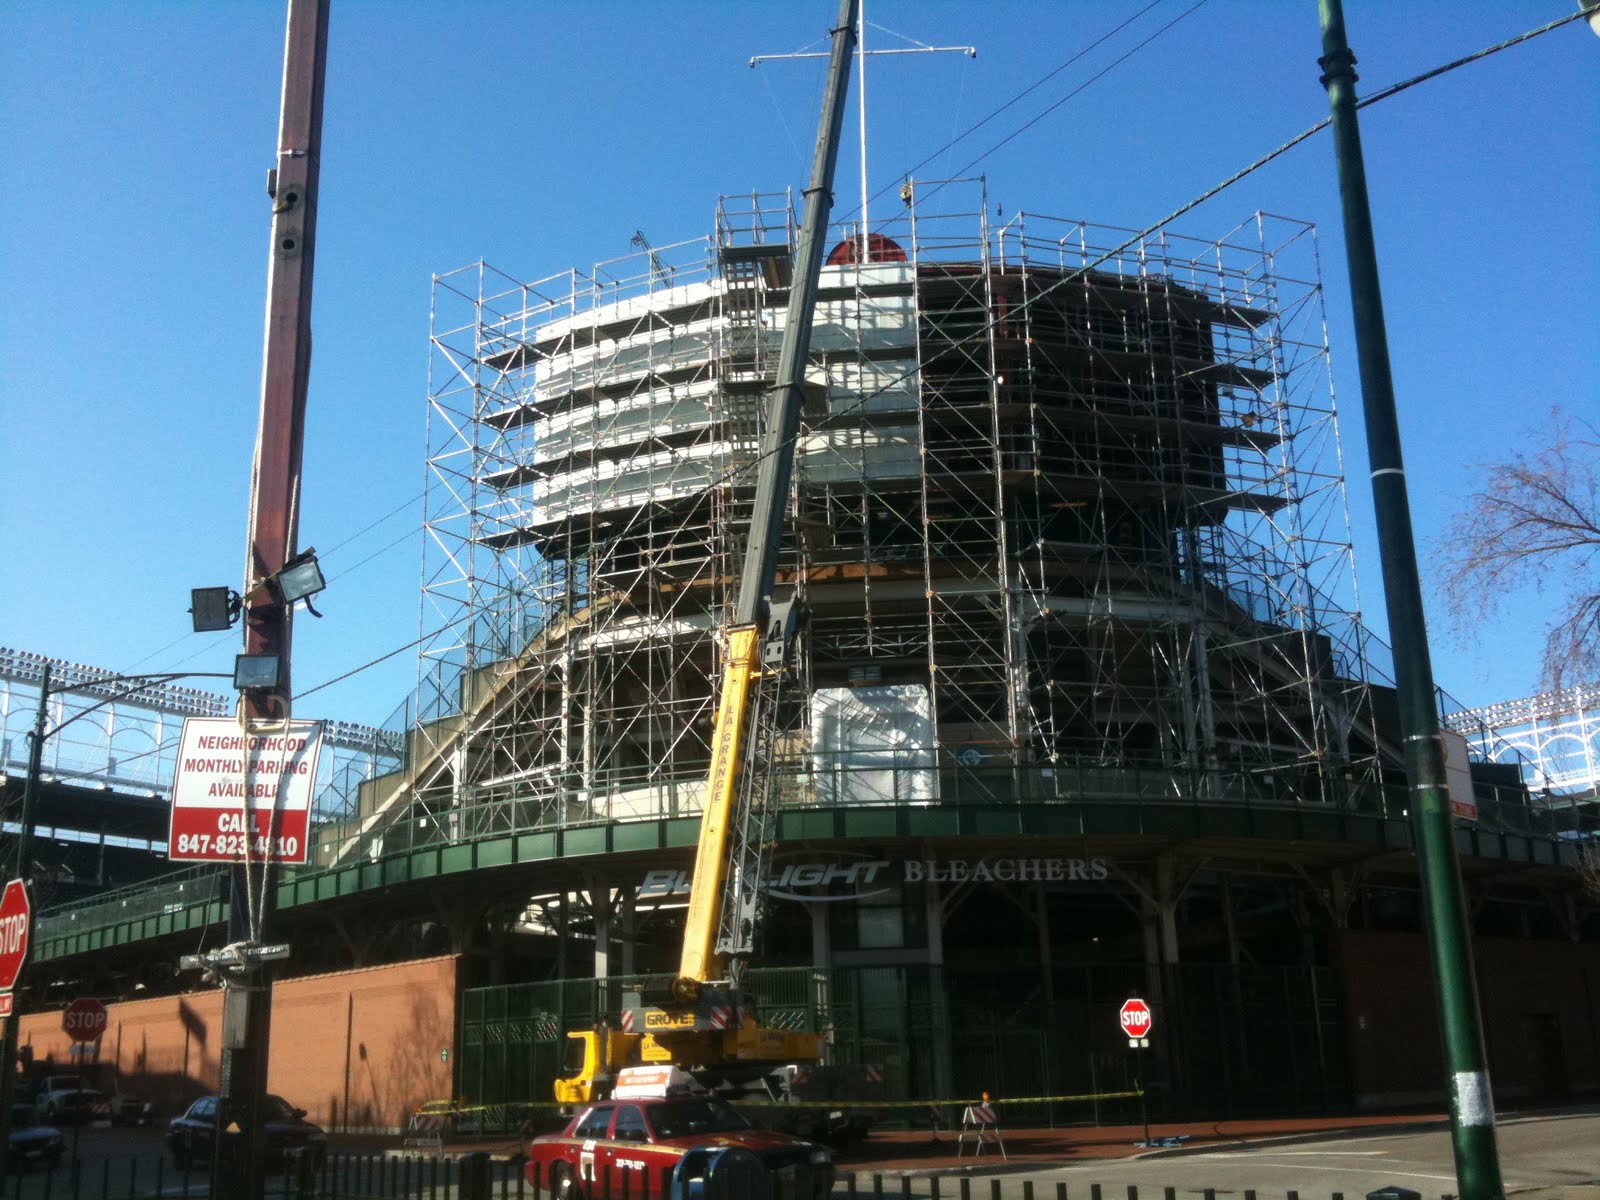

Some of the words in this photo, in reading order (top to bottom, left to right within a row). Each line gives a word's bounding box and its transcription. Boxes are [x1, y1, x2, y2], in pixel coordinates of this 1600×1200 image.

[713, 733, 731, 801] GRANGE
[904, 858, 1108, 882] BLEACHERS
[66, 1011, 105, 1029] STOP
[647, 1014, 689, 1026] GROVE
[1123, 1011, 1148, 1026] STOP
